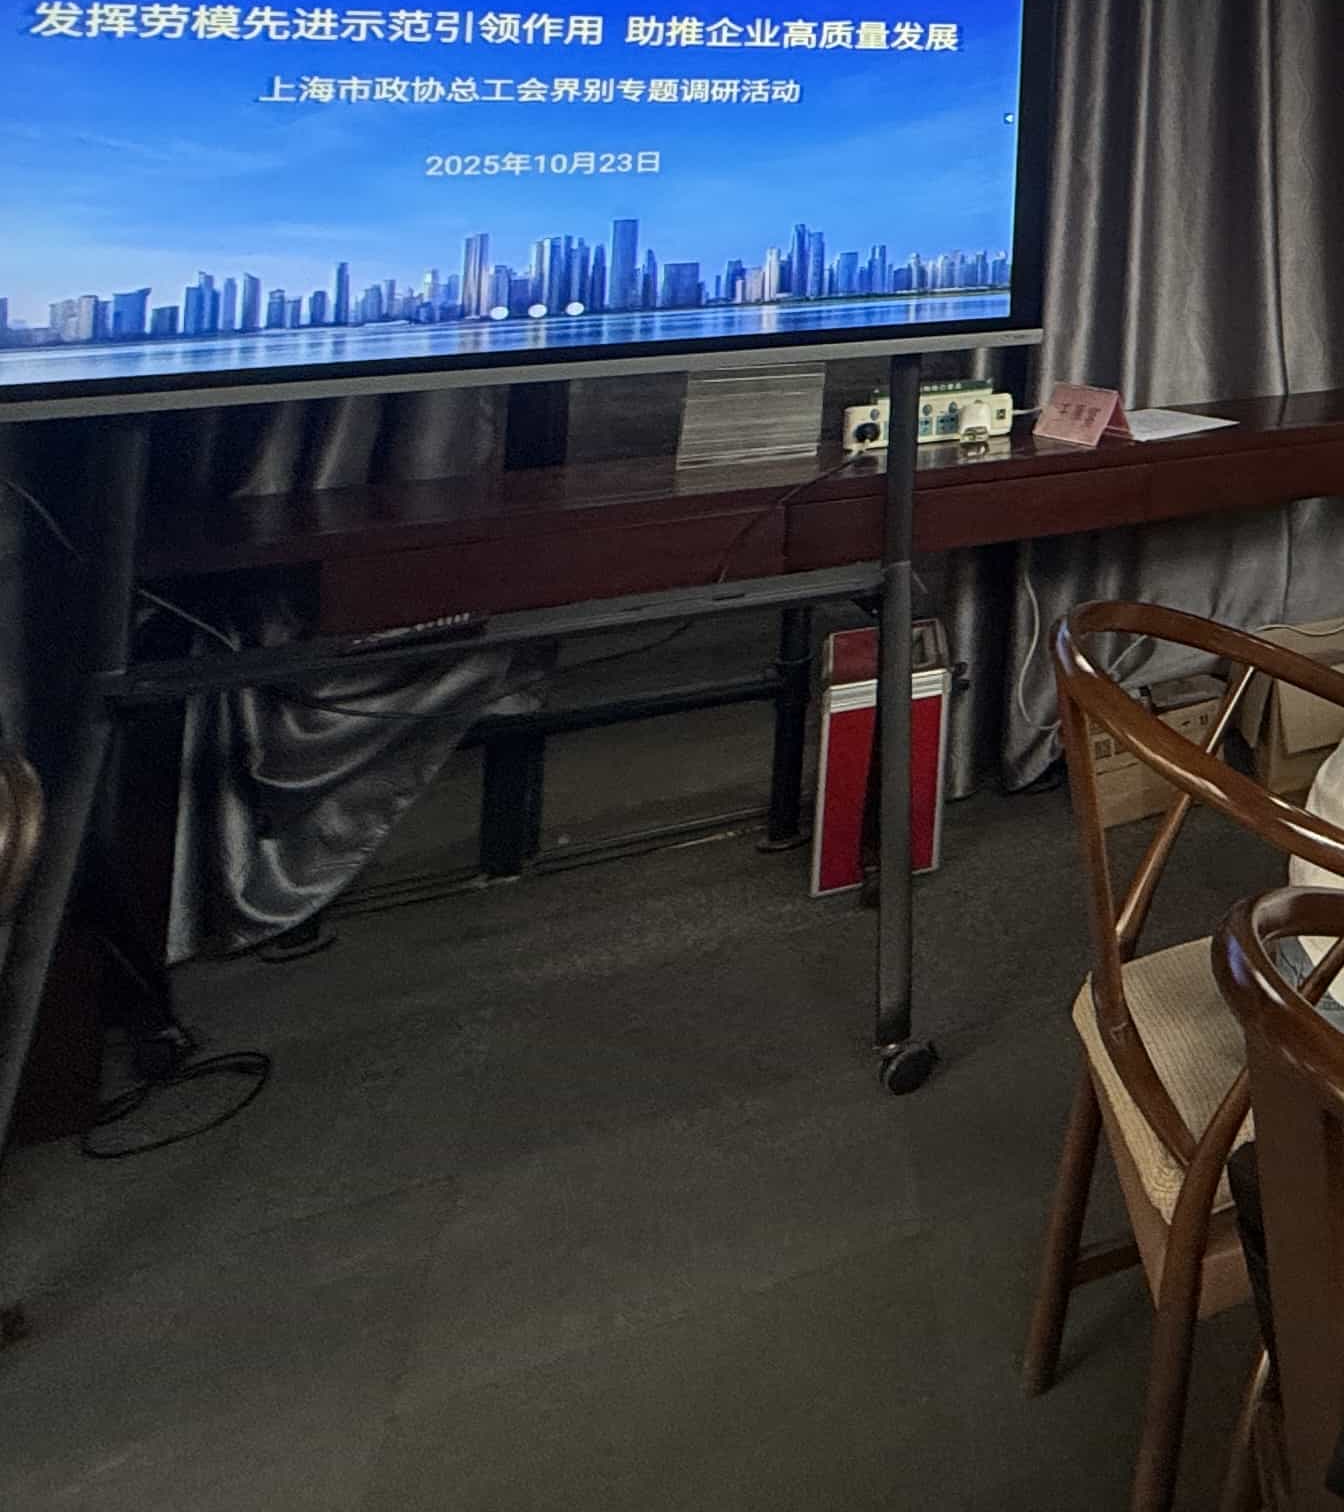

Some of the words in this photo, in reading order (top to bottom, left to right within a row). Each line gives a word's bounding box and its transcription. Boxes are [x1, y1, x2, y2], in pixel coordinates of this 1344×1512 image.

[29, 0, 603, 46] 发挥劳模先进示范引领作用
[624, 15, 959, 52] 助推企业高质量发展
[258, 75, 801, 104] 上海市政协总工会界别专题调研活动
[424, 151, 662, 177] 2025年10月23日
